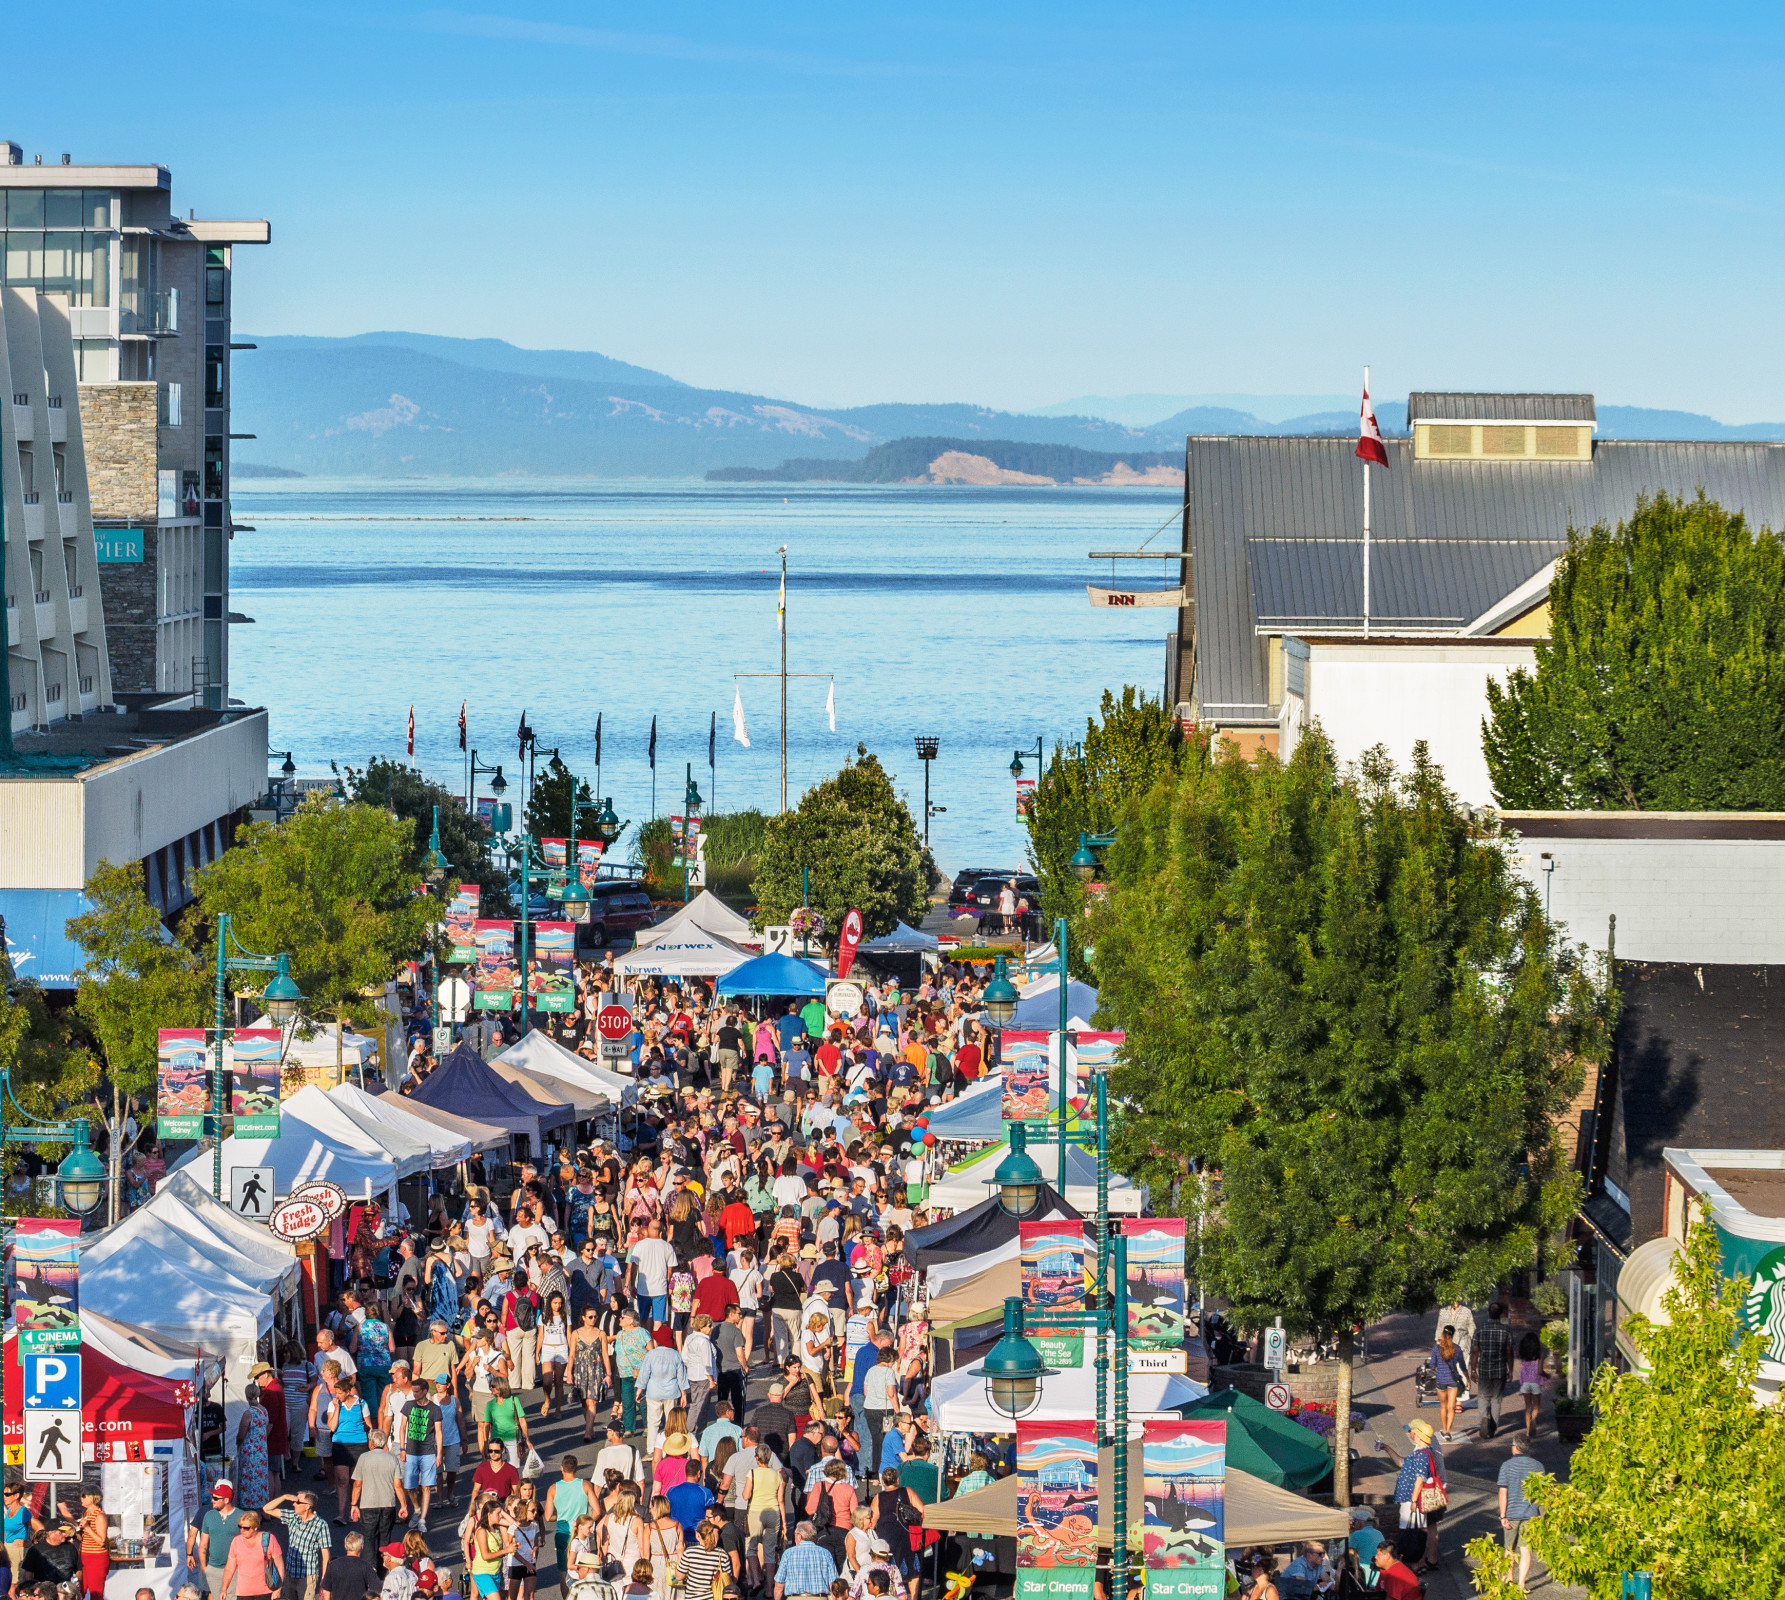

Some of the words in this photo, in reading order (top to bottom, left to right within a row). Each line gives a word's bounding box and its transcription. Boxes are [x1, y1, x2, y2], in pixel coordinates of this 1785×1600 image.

[95, 541, 139, 558] PIER
[1108, 594, 1135, 605] INN
[655, 943, 713, 952] Norwex
[624, 965, 663, 974] Norwex
[483, 993, 504, 1001] Buddies
[545, 995, 567, 1003] Buddies
[600, 1015, 629, 1029] STOP
[163, 1119, 191, 1127] Welcome
[192, 1119, 199, 1127] to
[281, 1204, 313, 1223] Fresh
[282, 1214, 317, 1234] Fudge
[37, 1331, 79, 1342] CINEMA
[1272, 1335, 1279, 1345] P
[1040, 1340, 1067, 1350] Beauty
[1044, 1349, 1056, 1357] the
[1057, 1349, 1072, 1358] Sea
[1138, 1359, 1168, 1368] Third
[36, 1357, 68, 1394] P
[411, 1407, 430, 1418] NEW
[408, 1415, 429, 1426] TOWN
[408, 1431, 426, 1441] CREW
[1023, 1581, 1047, 1593] Star
[1048, 1581, 1089, 1593] Cinema
[1152, 1582, 1174, 1594] Star
[1177, 1582, 1218, 1594] Cinema
